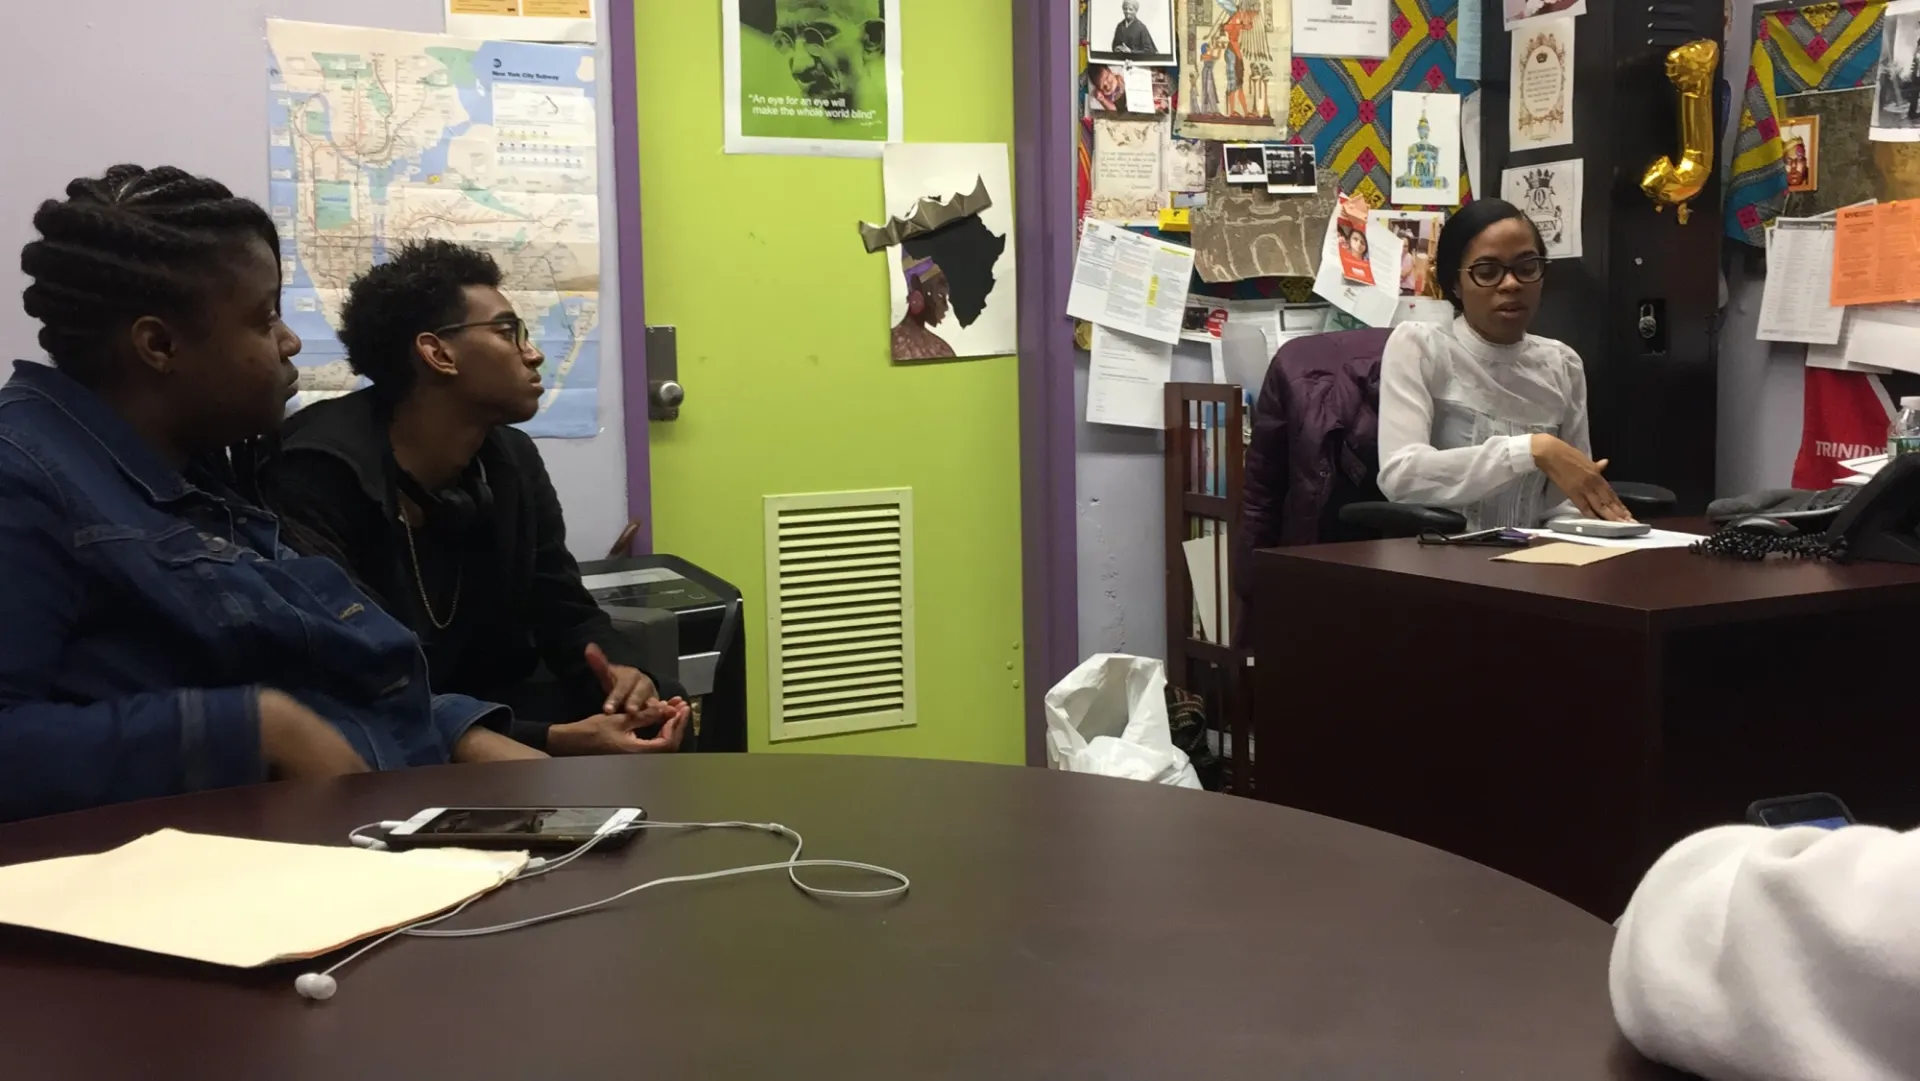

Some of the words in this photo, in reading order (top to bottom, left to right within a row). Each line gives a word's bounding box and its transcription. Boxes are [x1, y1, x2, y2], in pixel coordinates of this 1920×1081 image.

[535, 73, 559, 81] Subway
[767, 96, 783, 106] eye
[785, 95, 799, 105] for
[800, 97, 812, 105] an
[813, 98, 829, 108] eye
[831, 98, 846, 107] will
[752, 106, 778, 115] make
[780, 106, 795, 116] the
[796, 107, 824, 117] whole
[824, 109, 850, 119] world
